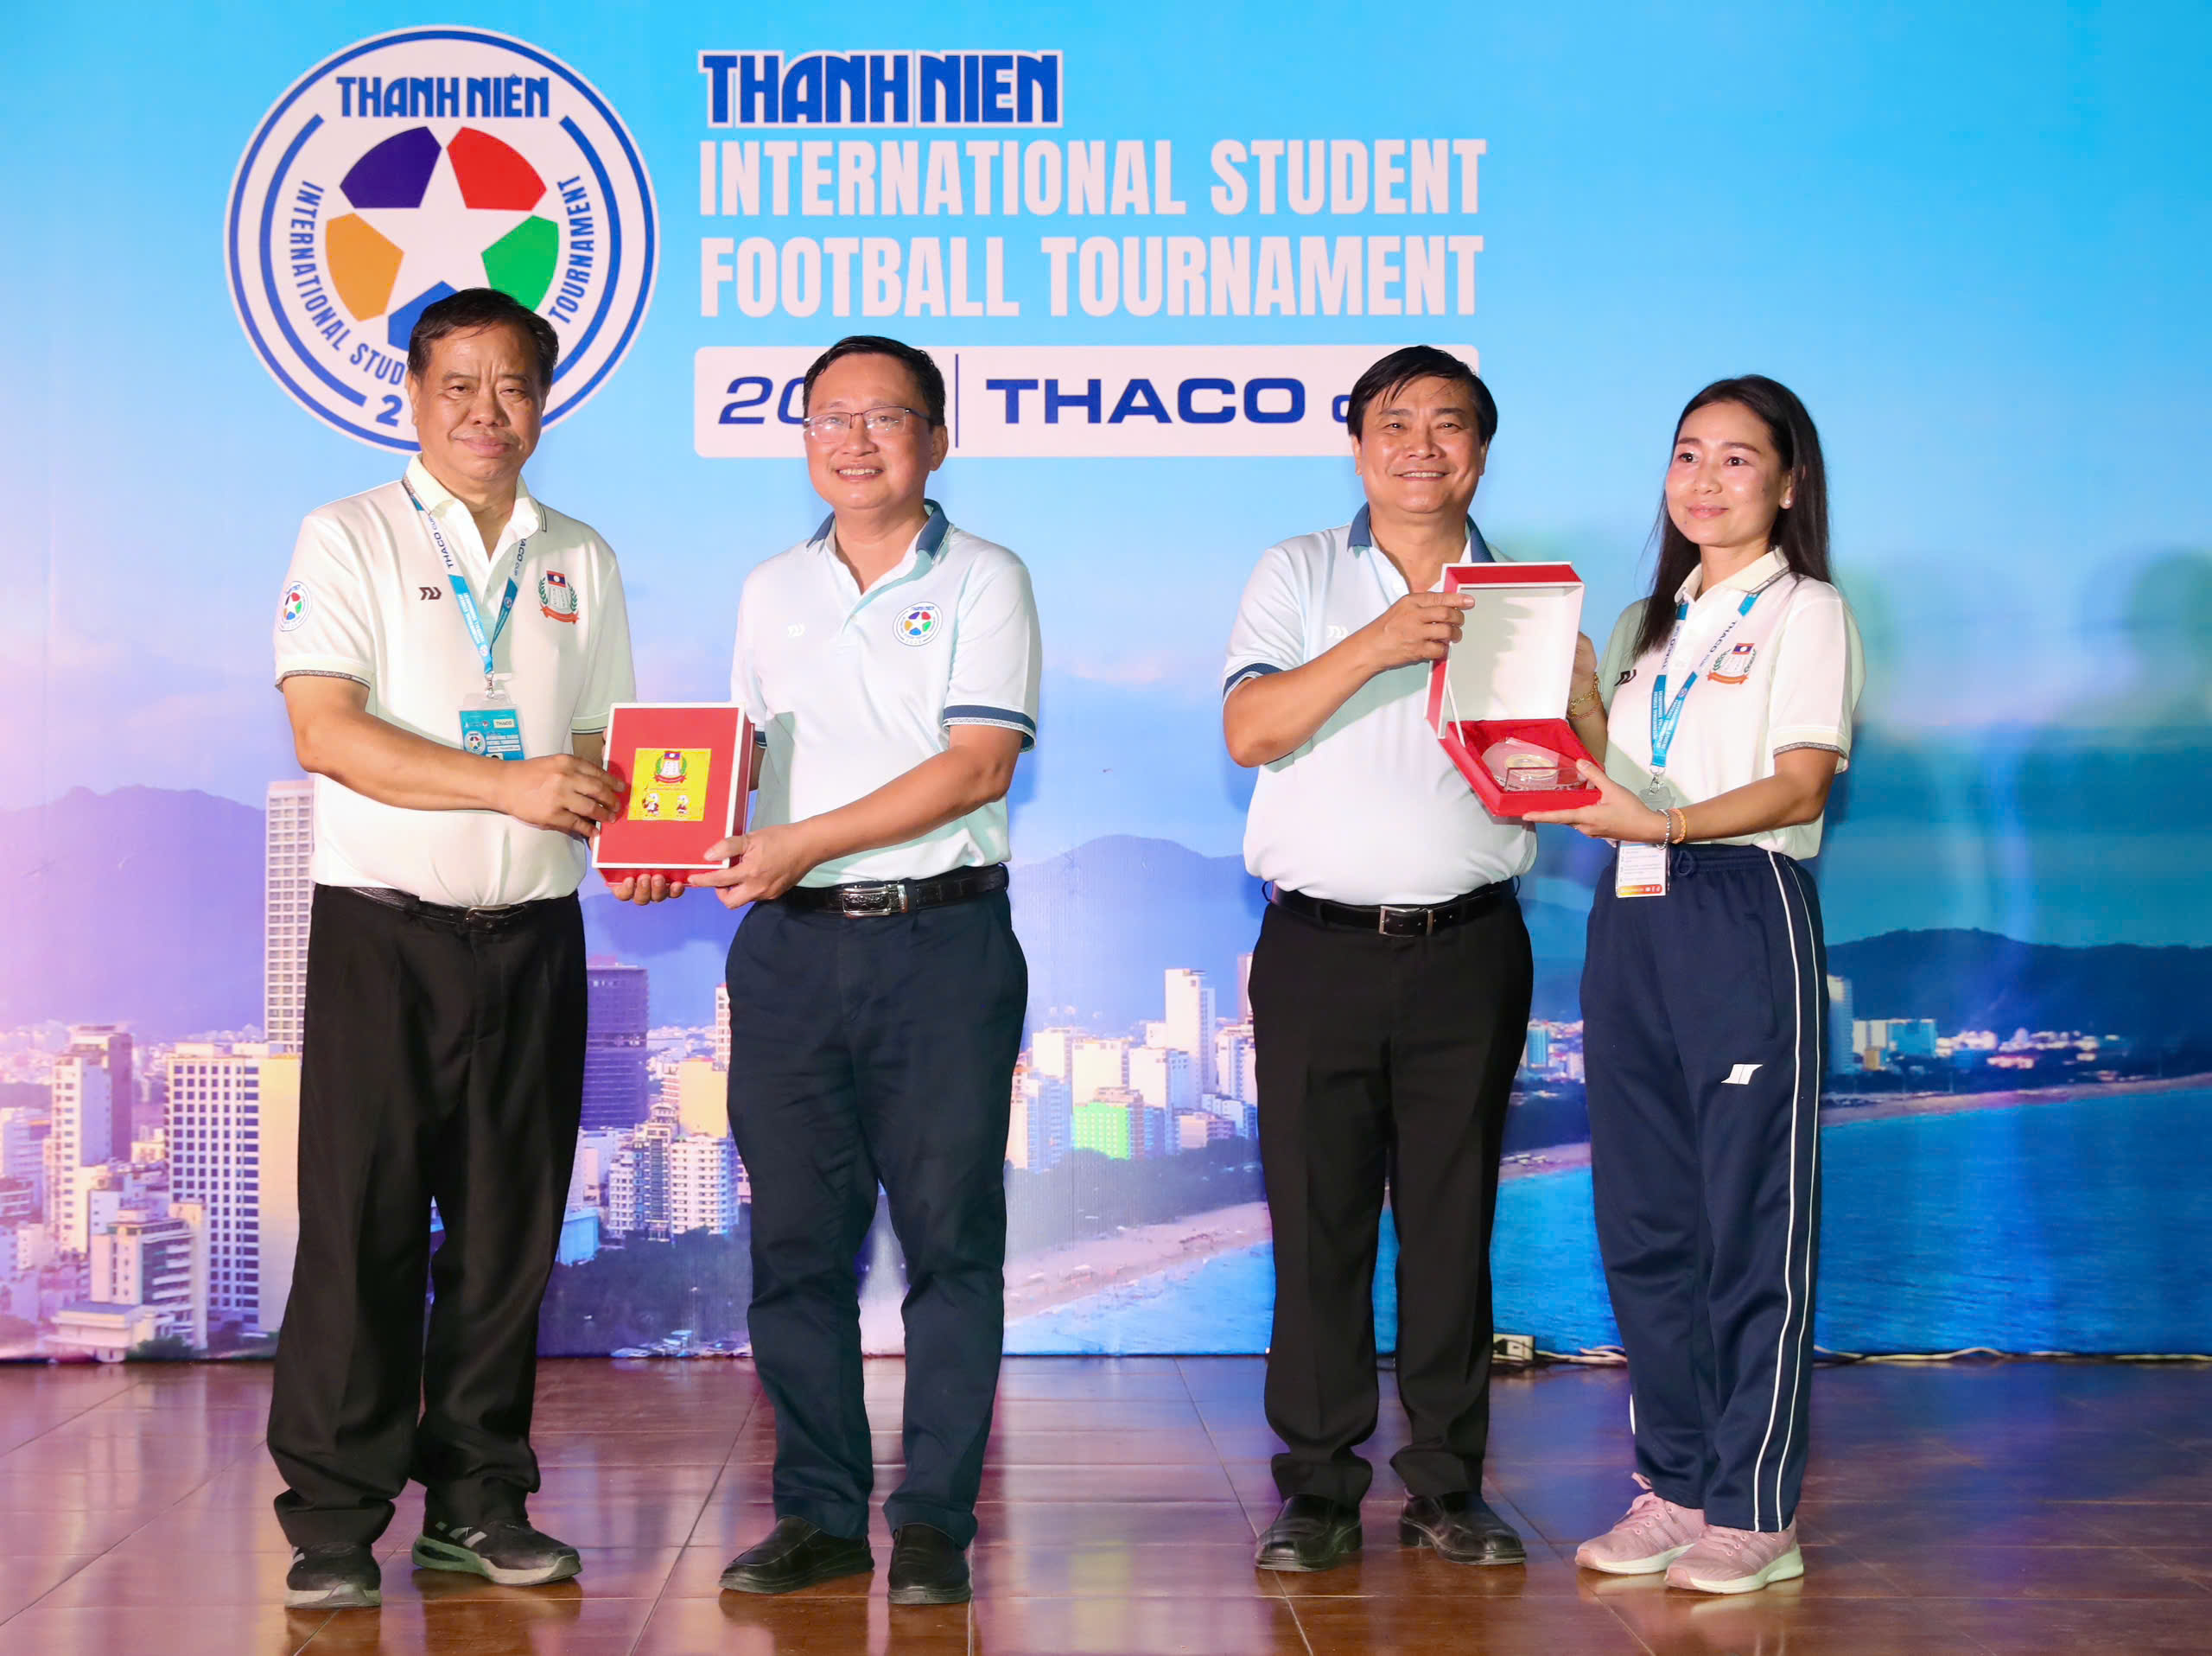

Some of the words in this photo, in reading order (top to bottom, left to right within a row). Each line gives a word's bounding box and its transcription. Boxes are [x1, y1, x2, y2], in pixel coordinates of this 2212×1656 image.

[336, 76, 460, 118] THANH
[467, 73, 550, 118] NIÊN
[702, 54, 910, 124] THANH
[700, 139, 1186, 215] INTERNATIONAL
[1211, 138, 1487, 215] STUDENT
[289, 180, 353, 351] INTERNATIONAL
[349, 342, 408, 386] STUD
[549, 175, 595, 324] TOURNAMENT
[700, 236, 1020, 318] FOOTBALL
[1041, 235, 1484, 318] TOURNAMENT
[985, 377, 1306, 424] THACO
[434, 532, 454, 569] THACO
